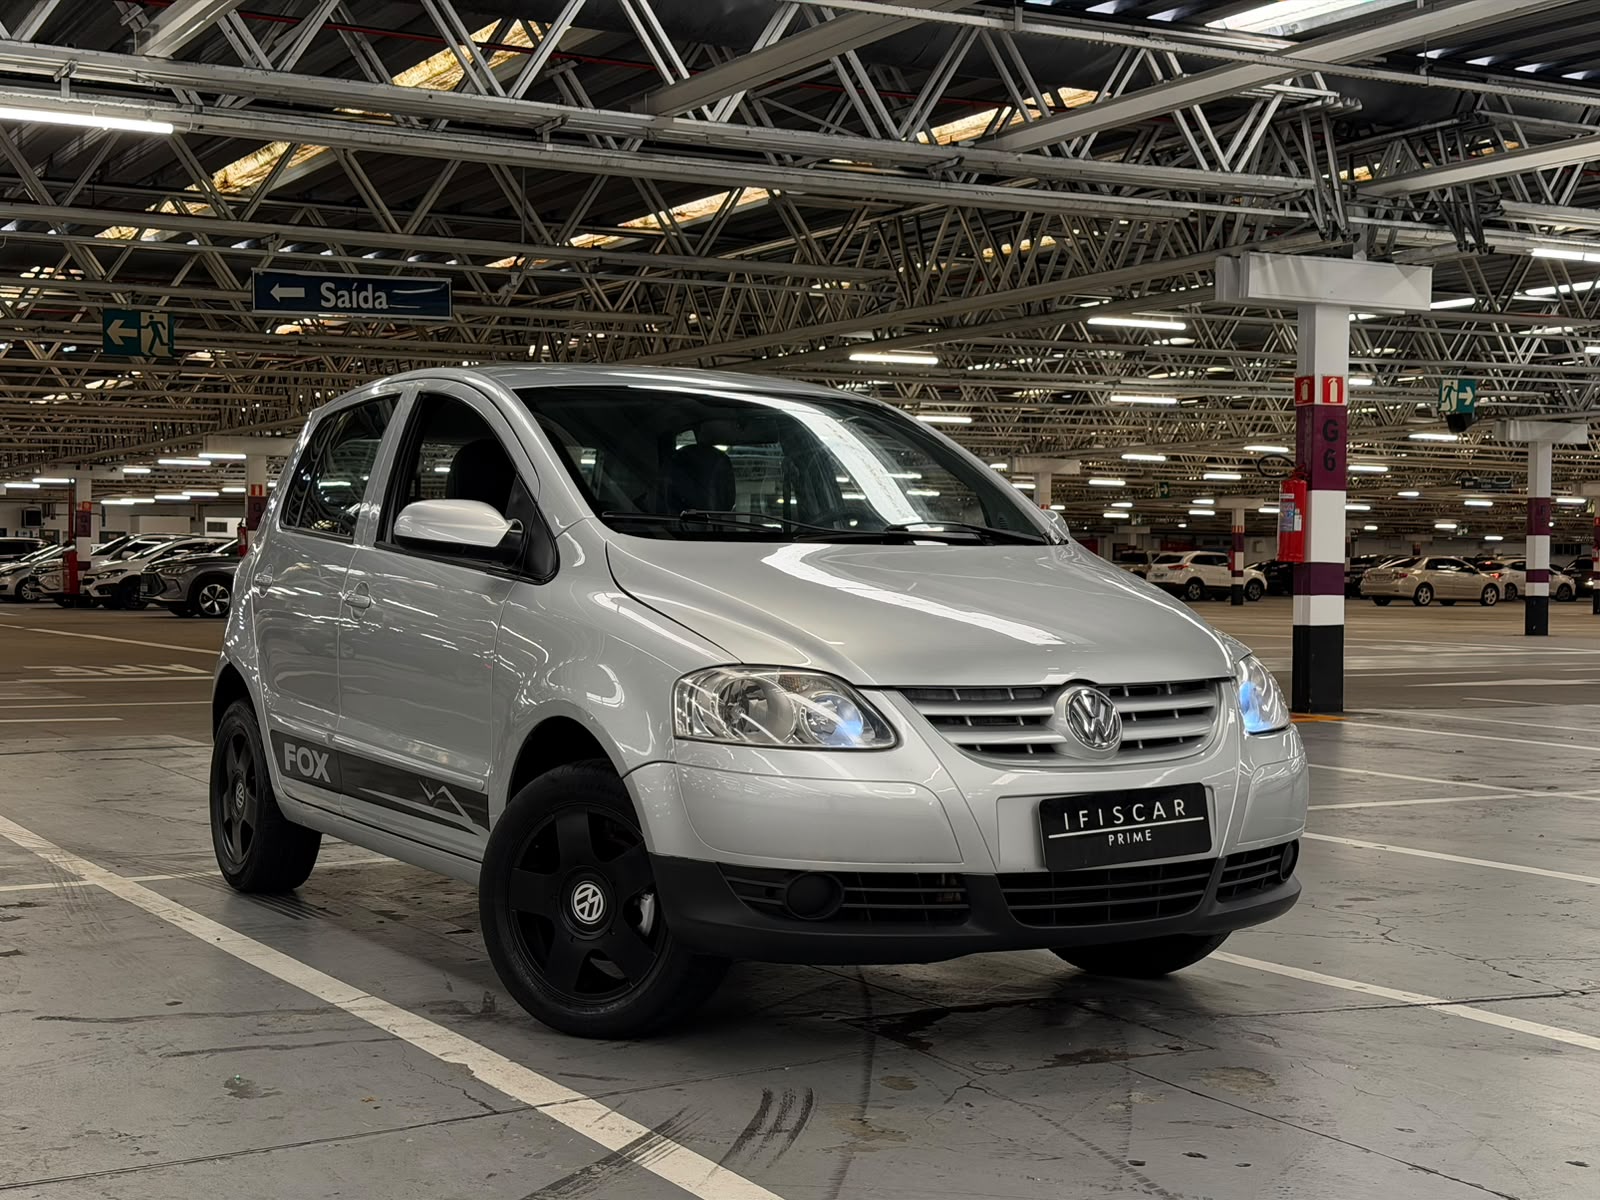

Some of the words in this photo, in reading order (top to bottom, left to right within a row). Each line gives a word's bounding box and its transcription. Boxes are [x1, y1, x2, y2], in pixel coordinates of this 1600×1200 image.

[320, 281, 389, 310] Saída
[1322, 418, 1339, 442] G
[1323, 448, 1337, 471] 6
[23, 663, 212, 676] ARE
[283, 742, 331, 783] FOX
[1063, 799, 1186, 830] IFISCAR
[1107, 829, 1153, 846] PRIME
